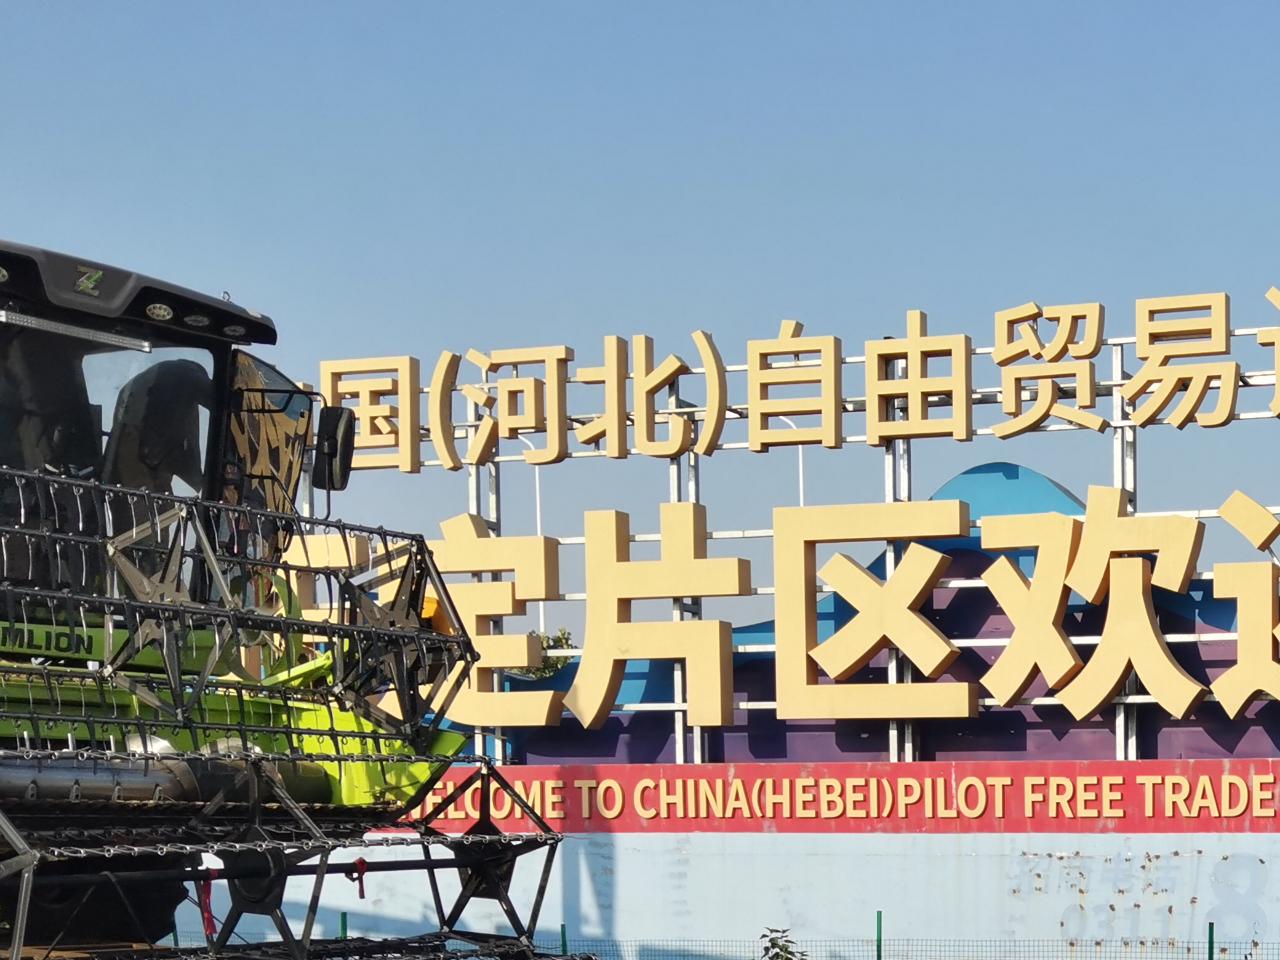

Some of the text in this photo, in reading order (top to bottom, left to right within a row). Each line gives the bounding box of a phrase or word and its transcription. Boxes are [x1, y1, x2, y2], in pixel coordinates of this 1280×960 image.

[401, 779, 565, 820] ELCOME
[574, 779, 624, 819] TO
[1023, 776, 1125, 818] FREE
[1136, 774, 1276, 818] TRADE
